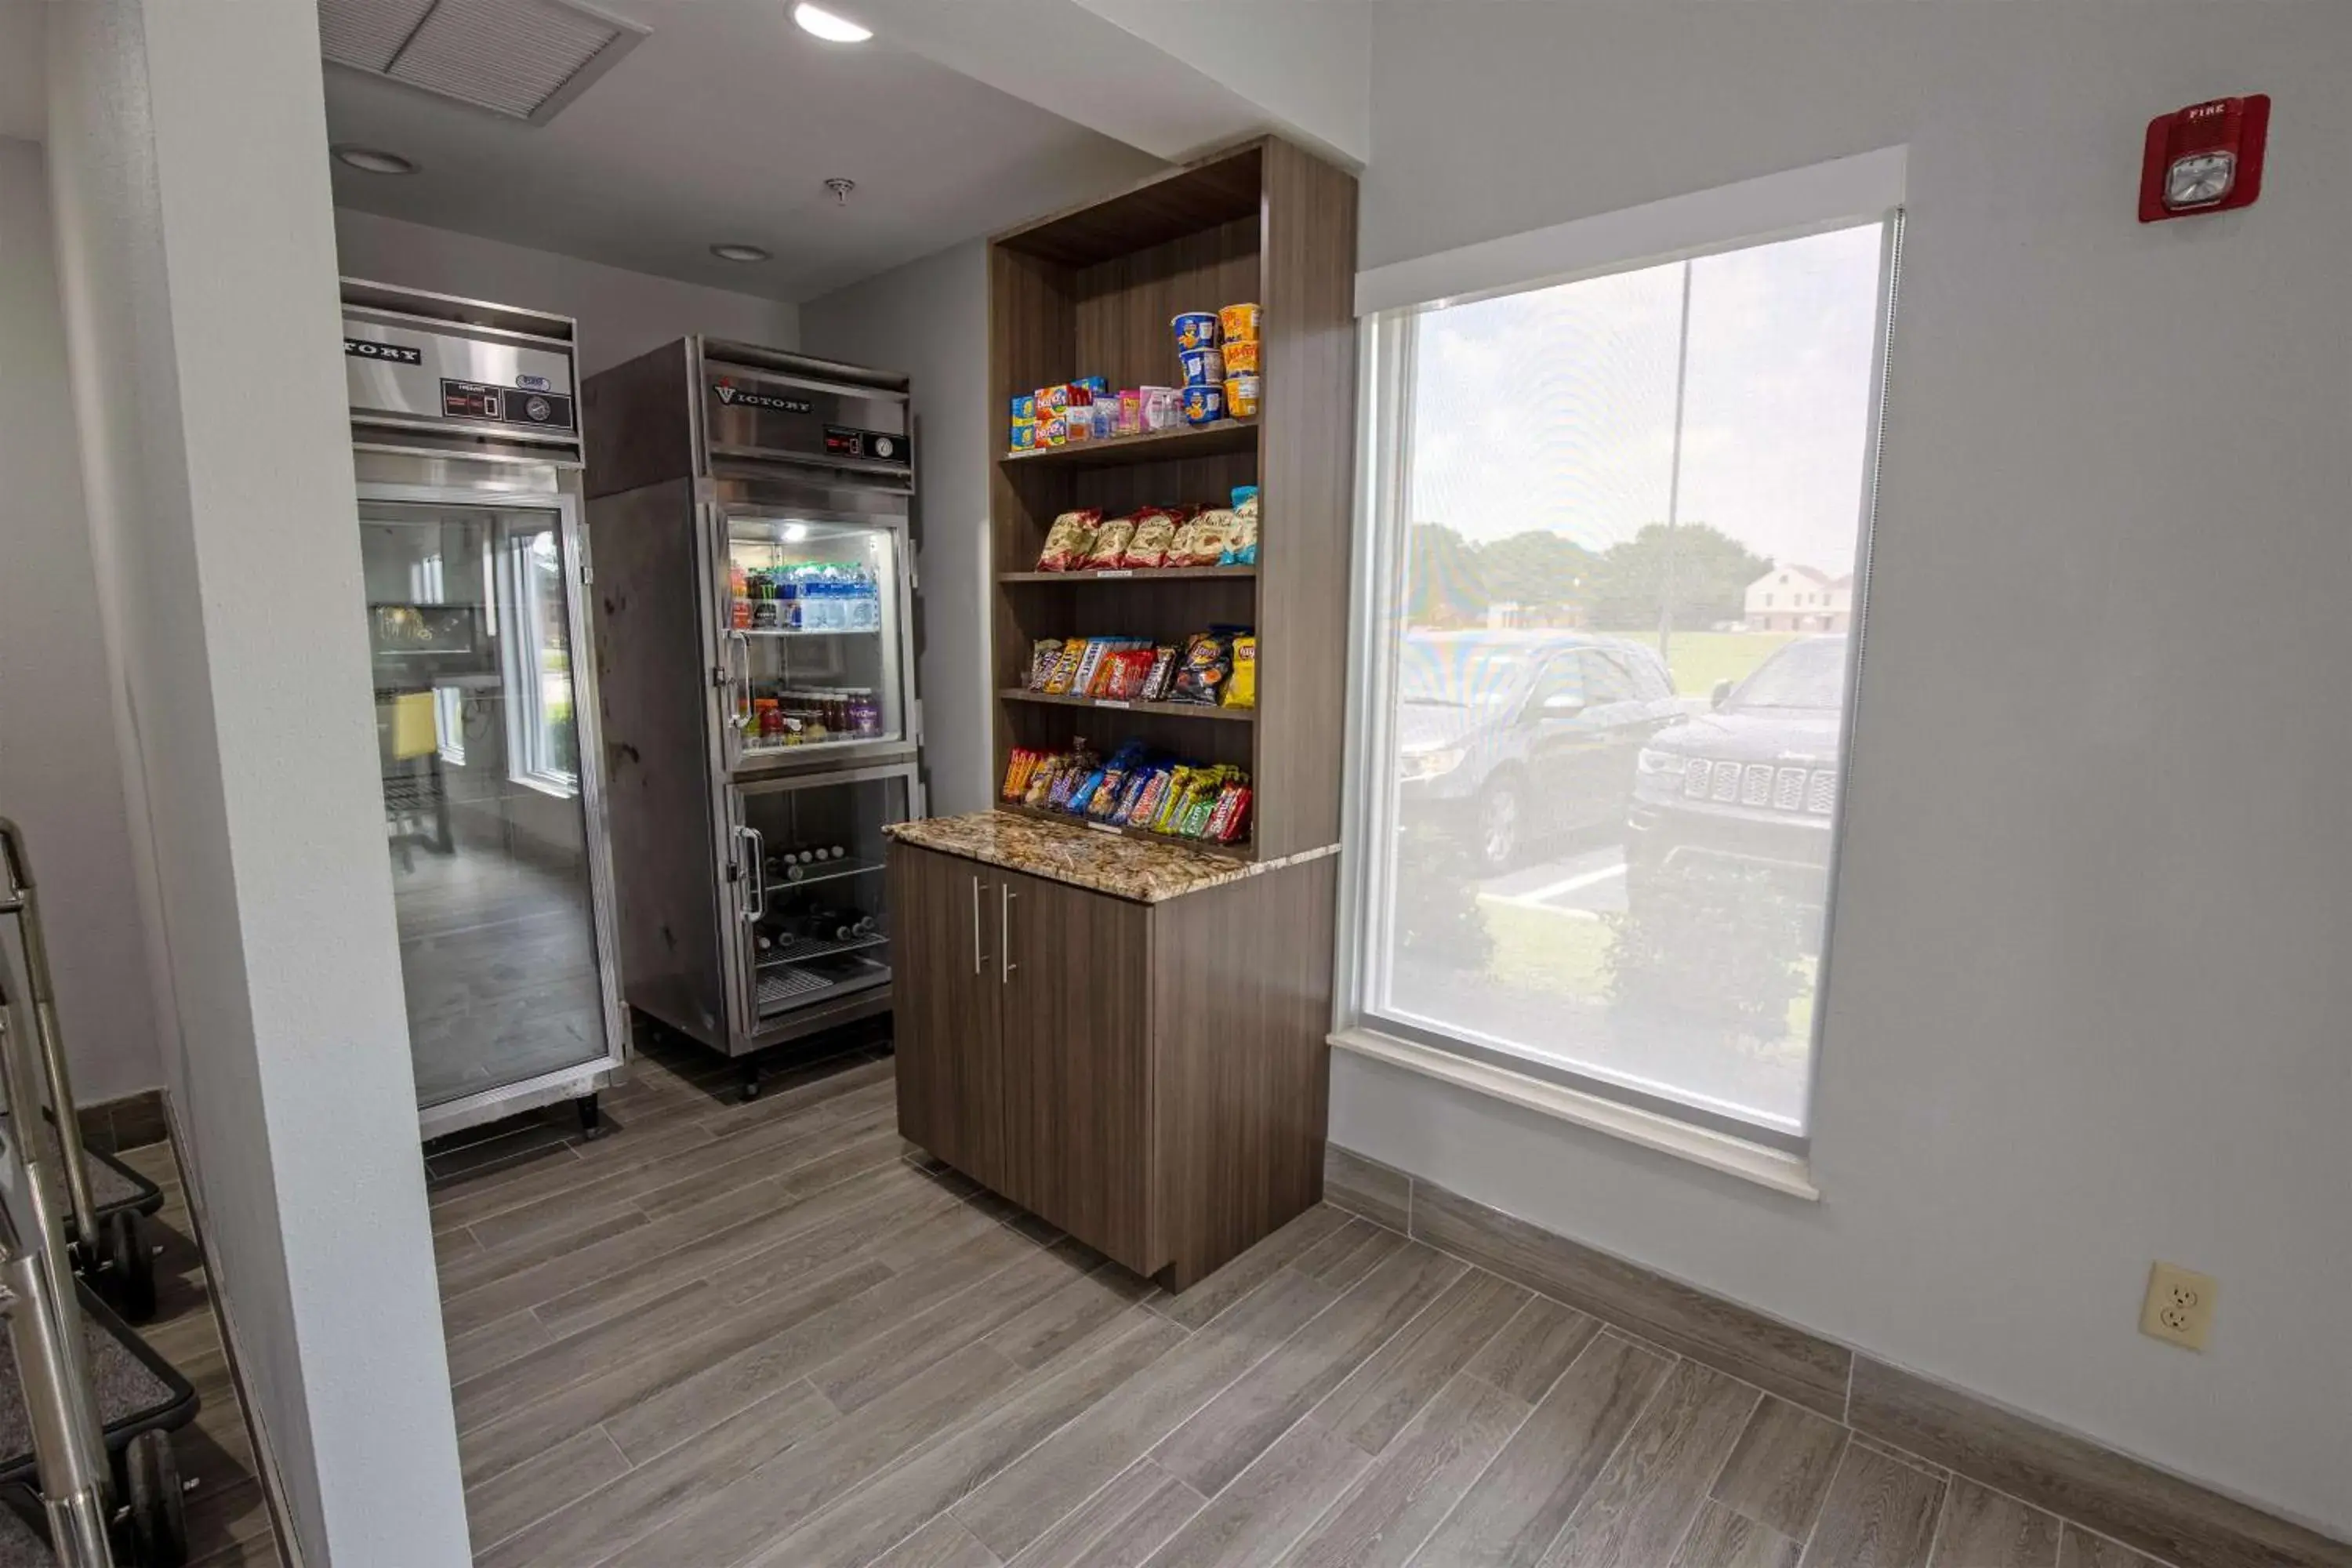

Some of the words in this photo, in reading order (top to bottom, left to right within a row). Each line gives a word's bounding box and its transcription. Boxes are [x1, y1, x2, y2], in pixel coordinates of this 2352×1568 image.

[2189, 103, 2226, 118] FIRE
[344, 343, 418, 360] TORY
[714, 386, 810, 412] VICTORY
